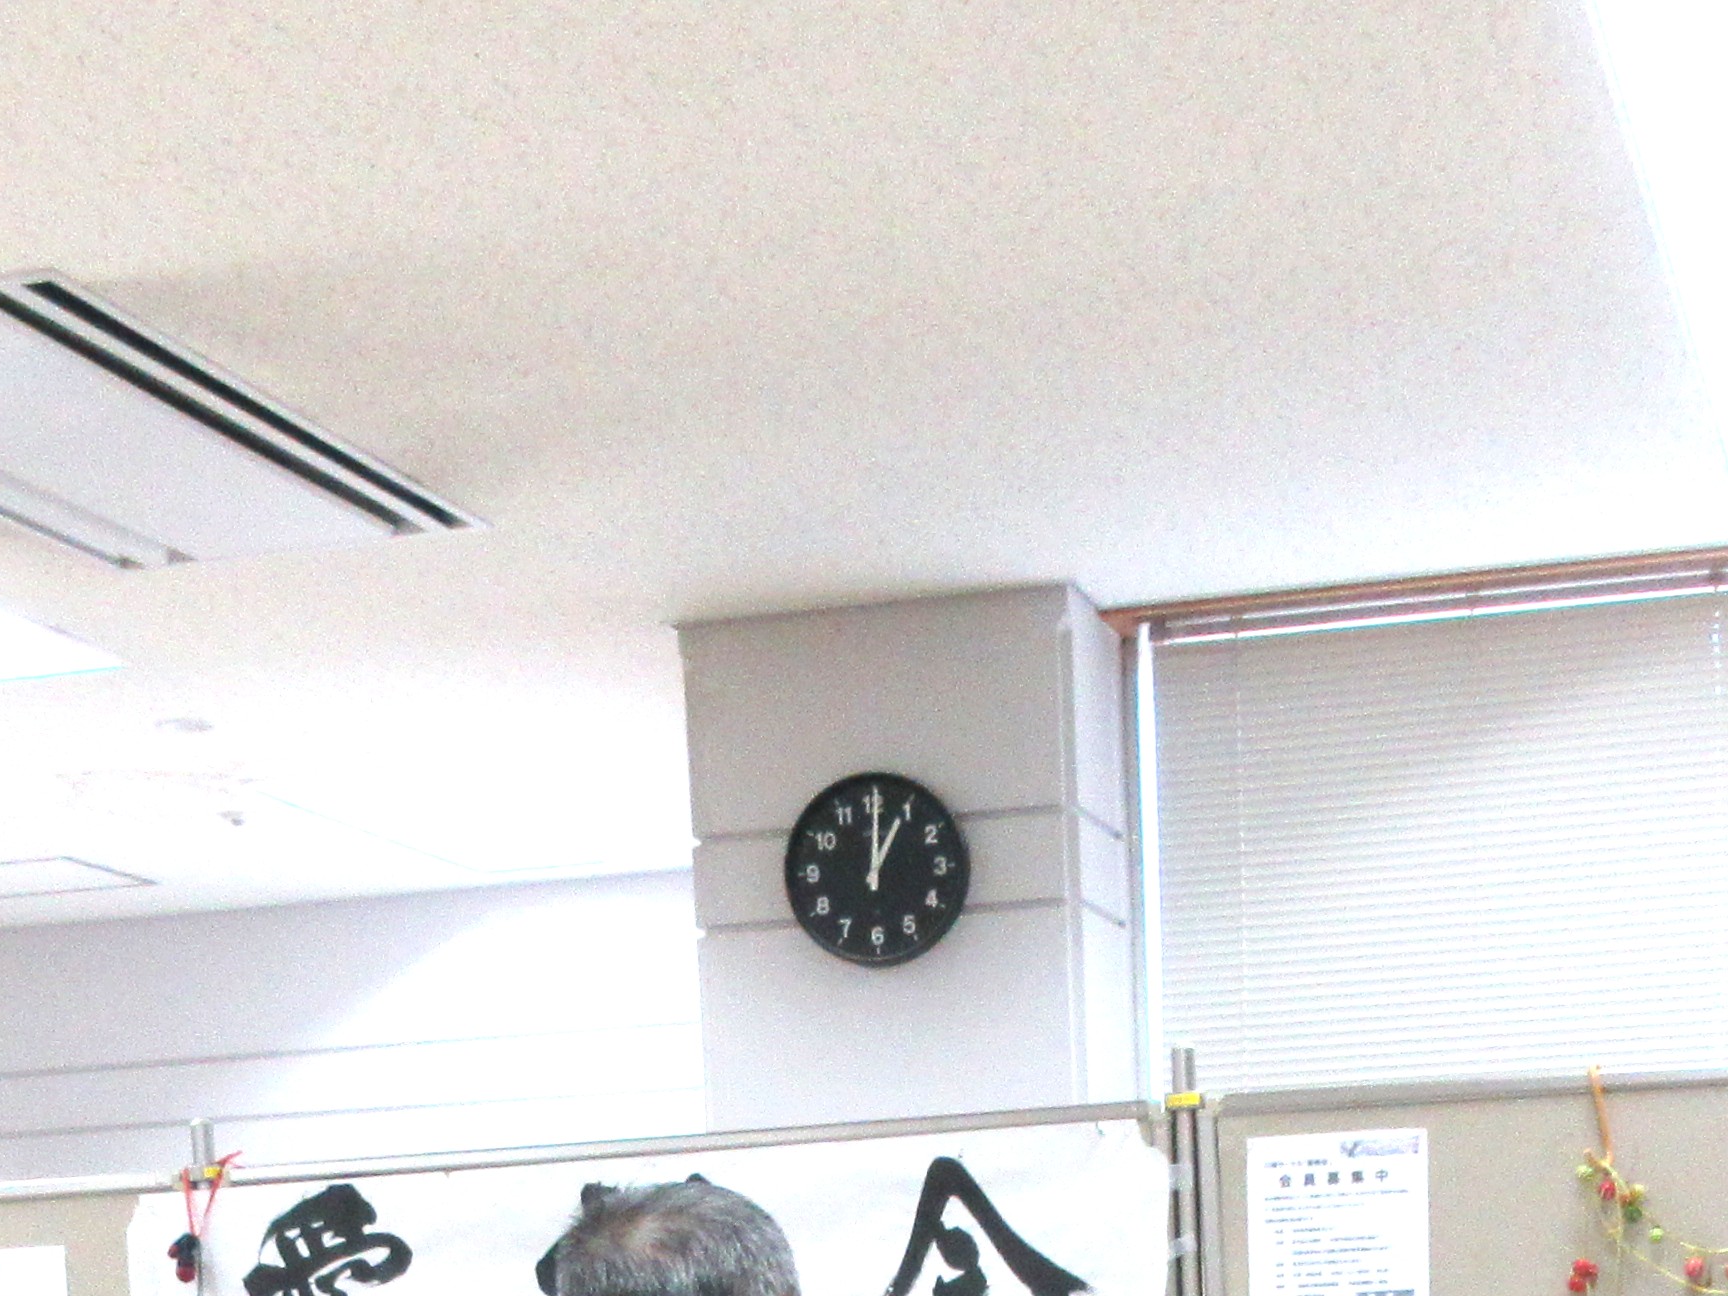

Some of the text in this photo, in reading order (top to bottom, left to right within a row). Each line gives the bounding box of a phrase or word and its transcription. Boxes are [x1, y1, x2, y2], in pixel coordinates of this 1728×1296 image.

[835, 806, 852, 825] 11
[902, 802, 911, 821] 1
[815, 832, 837, 850] 10
[924, 825, 938, 844] 2
[806, 865, 820, 883] 9
[933, 857, 947, 876] 3
[816, 897, 830, 915] 8
[925, 889, 938, 908] 4
[838, 918, 852, 938] 7
[902, 915, 916, 934] 5
[871, 927, 884, 945] 6
[1279, 1169, 1389, 1188] 会員募集中
